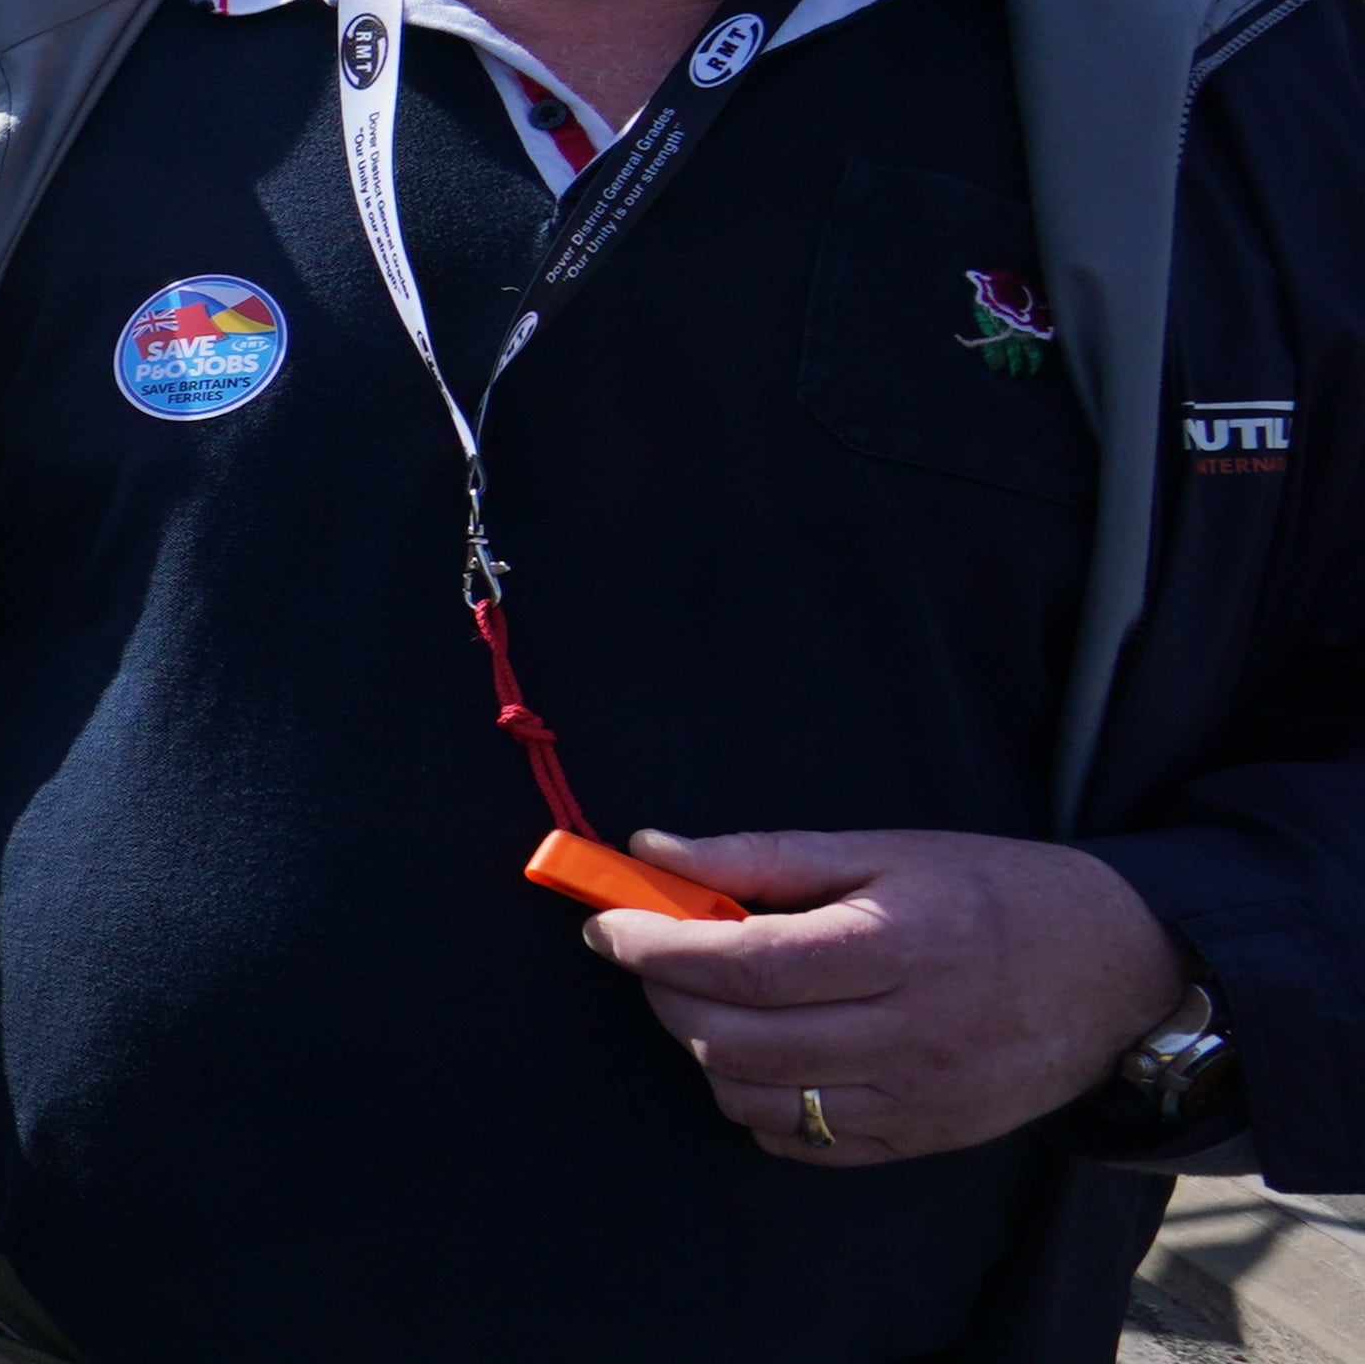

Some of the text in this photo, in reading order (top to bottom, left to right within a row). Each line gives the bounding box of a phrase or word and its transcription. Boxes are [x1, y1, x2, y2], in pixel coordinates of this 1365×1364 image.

[354, 30, 373, 73] RMT
[706, 25, 748, 71] RMT
[369, 111, 380, 148] Dover
[357, 159, 368, 193] Unity
[370, 151, 382, 197] District
[546, 108, 674, 283] Dover District General Grades
[586, 221, 616, 253] Unity
[612, 208, 626, 220] is
[624, 184, 643, 205] our
[147, 335, 217, 362] SAVE
[135, 353, 260, 383] P&O JOBS
[141, 377, 252, 396] SAVE BRITAIN'S
[167, 391, 224, 405] FERRIES
